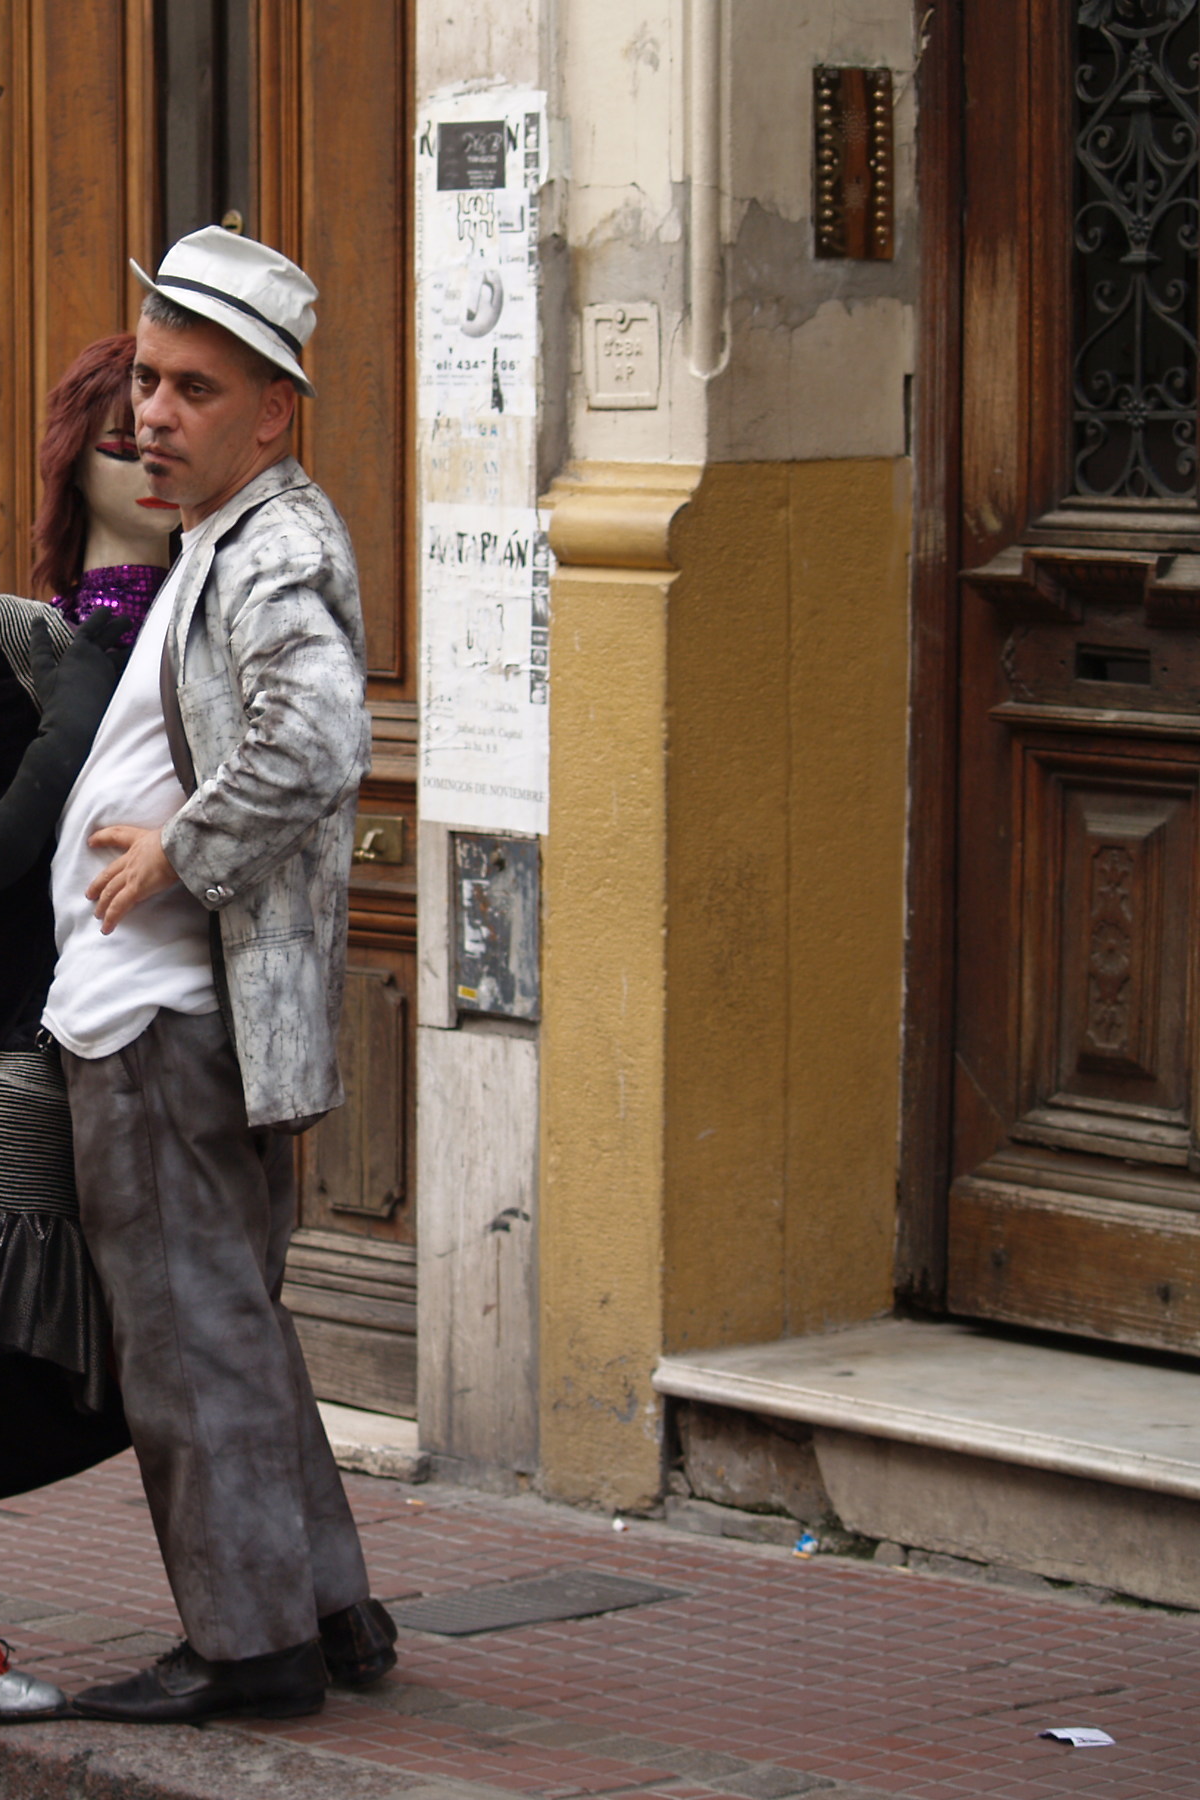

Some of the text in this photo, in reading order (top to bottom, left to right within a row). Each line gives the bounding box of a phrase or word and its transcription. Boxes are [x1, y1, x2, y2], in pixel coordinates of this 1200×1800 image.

[433, 359, 453, 371] el:
[423, 776, 545, 802] DOMINGOS DE NOVIEMBRE
